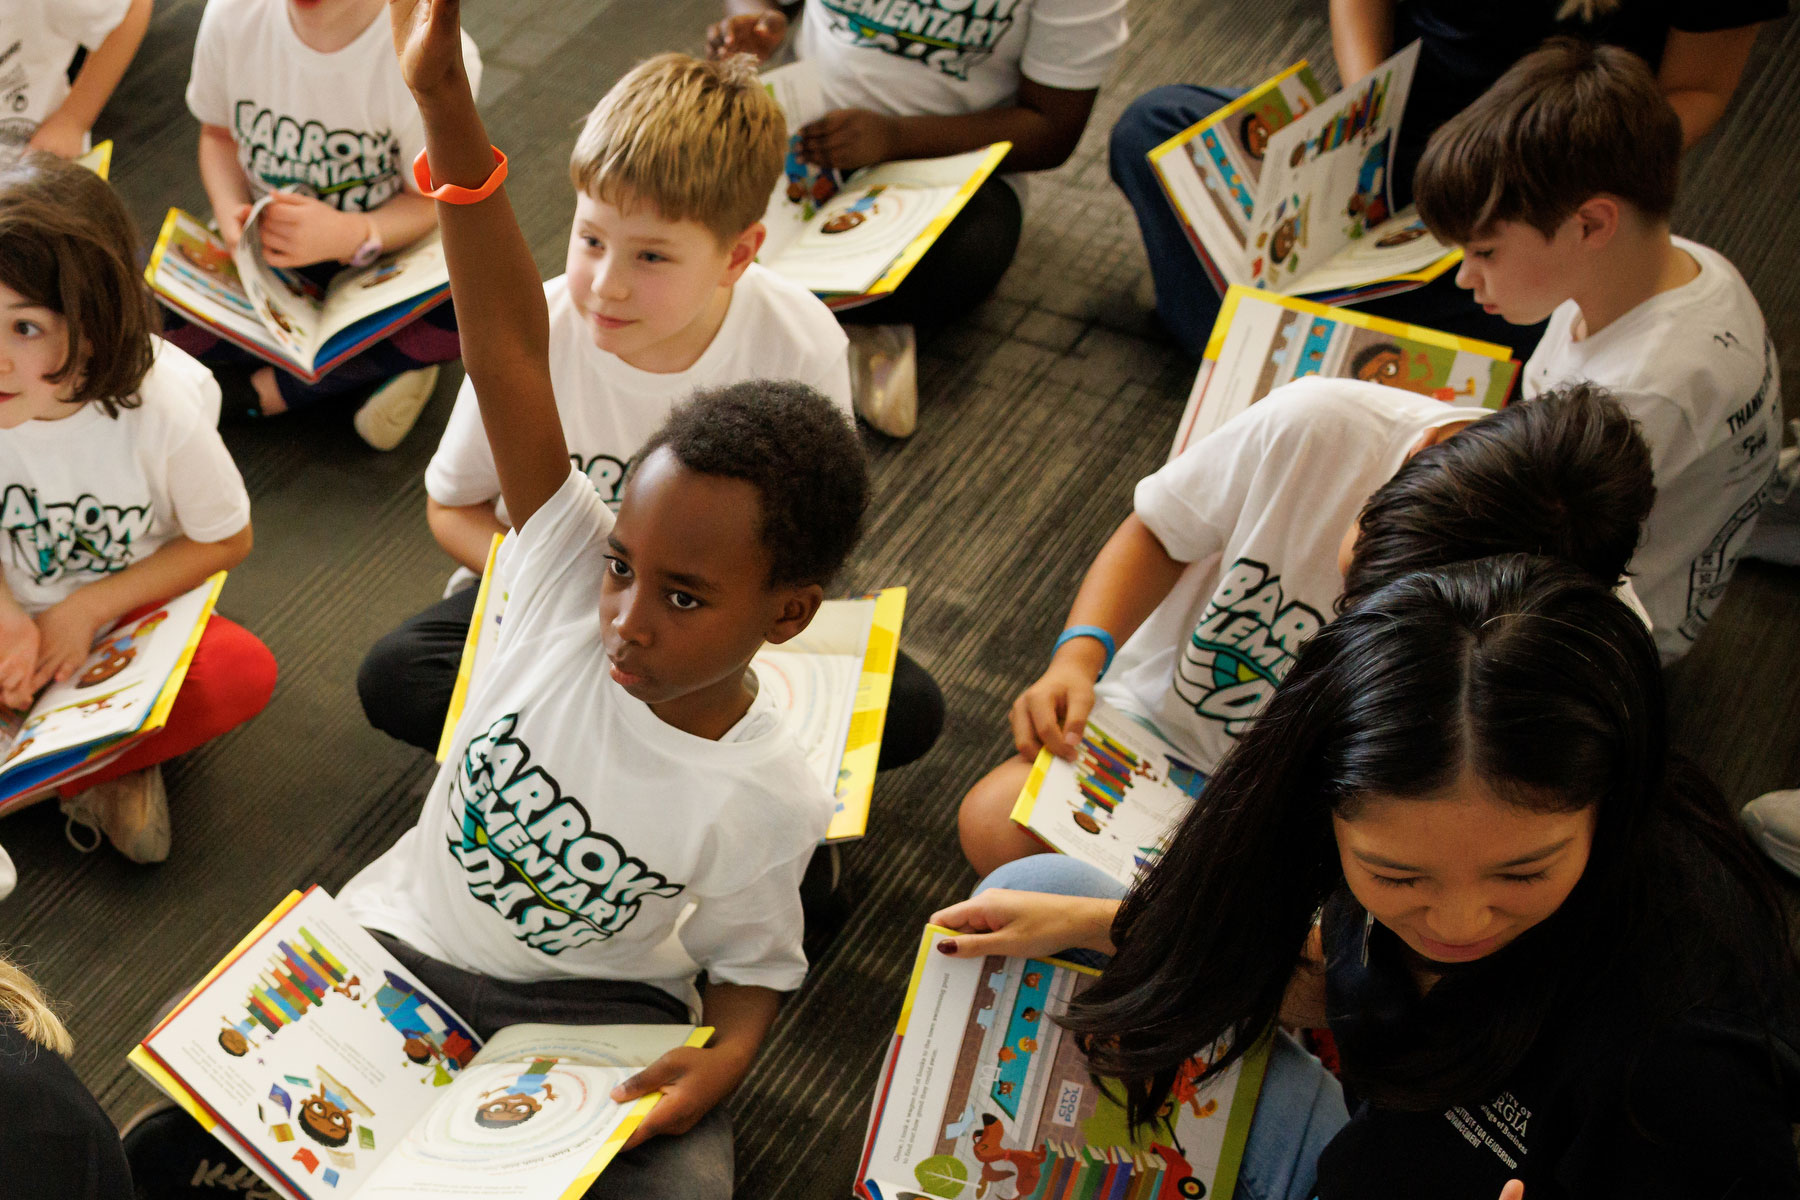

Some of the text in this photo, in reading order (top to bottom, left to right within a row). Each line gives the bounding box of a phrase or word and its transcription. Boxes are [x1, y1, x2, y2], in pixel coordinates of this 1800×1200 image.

[1058, 1086, 1072, 1117] CITY
[1064, 1087, 1080, 1122] POOL
[1492, 1095, 1528, 1138] RGIA
[1444, 1109, 1481, 1149] ADVANCEMENT
[1474, 1124, 1487, 1140] FOR
[1484, 1135, 1518, 1170] LEADERSHIP
[1502, 1124, 1528, 1155] Business
